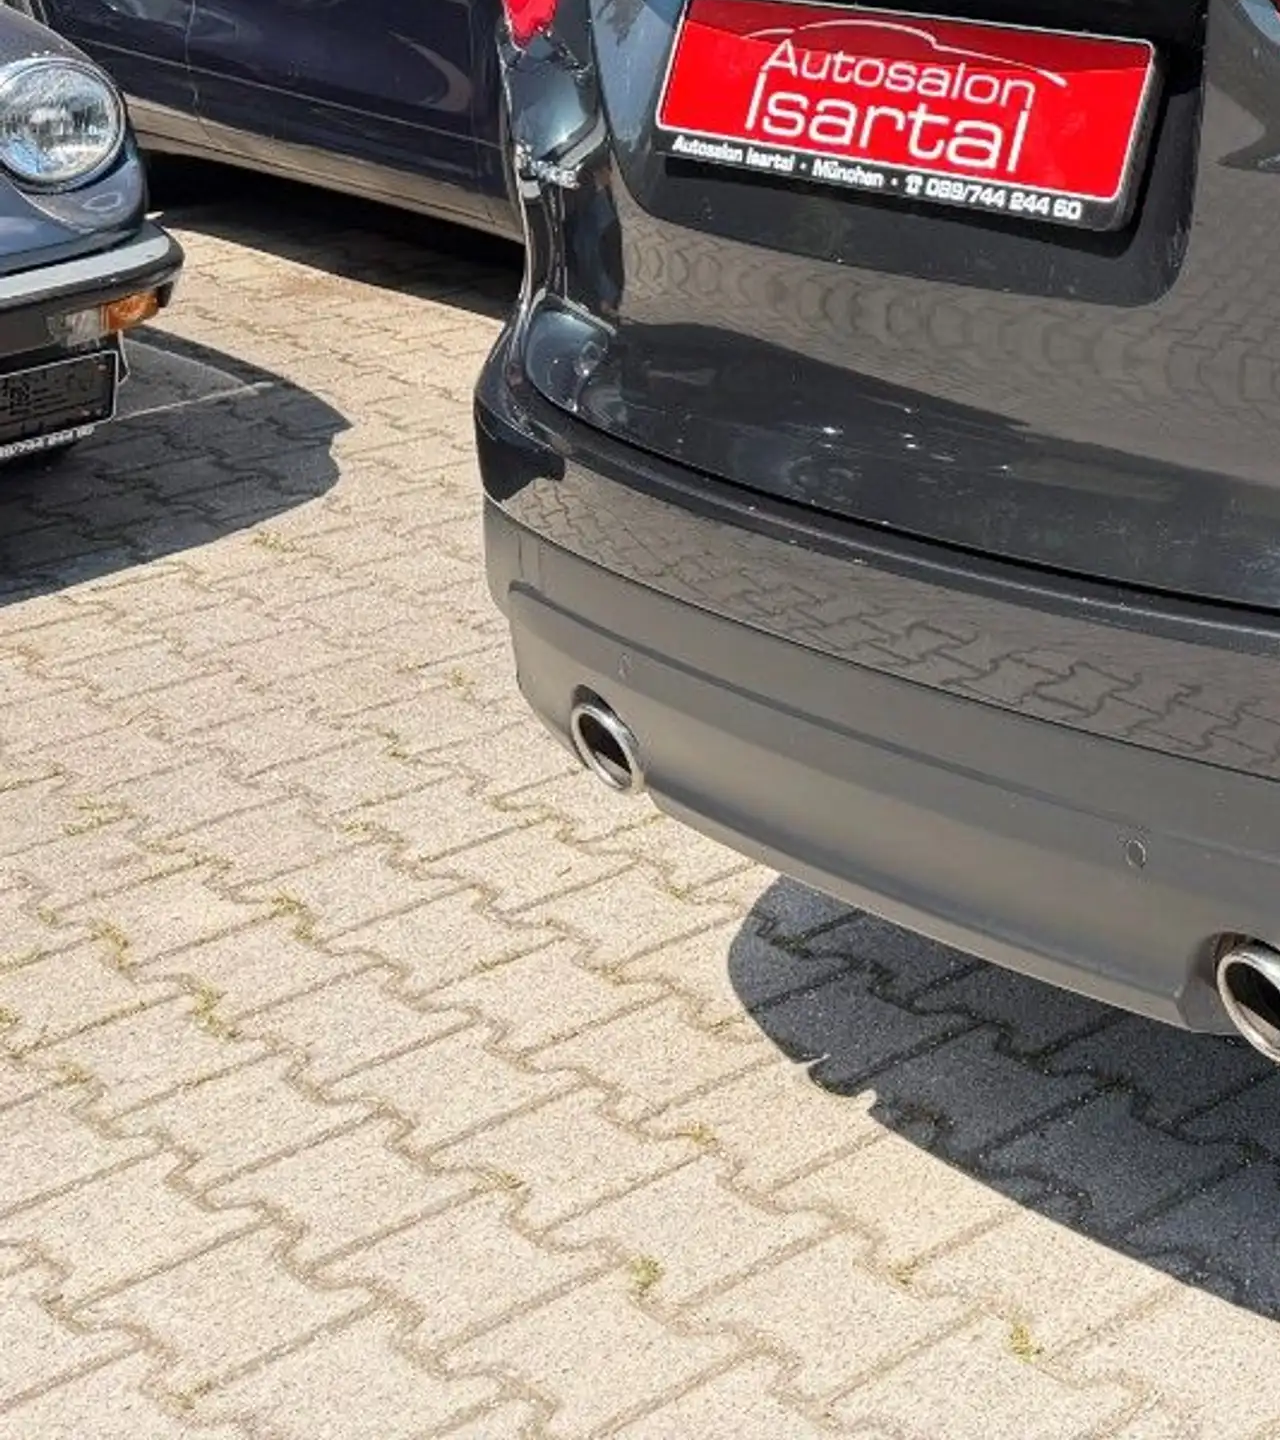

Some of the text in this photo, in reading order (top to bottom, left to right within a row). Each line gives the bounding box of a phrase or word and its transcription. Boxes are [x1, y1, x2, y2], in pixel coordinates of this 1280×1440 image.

[761, 37, 1036, 109] Autosalon
[744, 73, 1029, 173] Isartal
[672, 135, 743, 163] Autosalon
[746, 147, 796, 172] Isartal
[811, 158, 885, 188] München
[1008, 191, 1051, 215] 244
[1053, 198, 1083, 220] 60
